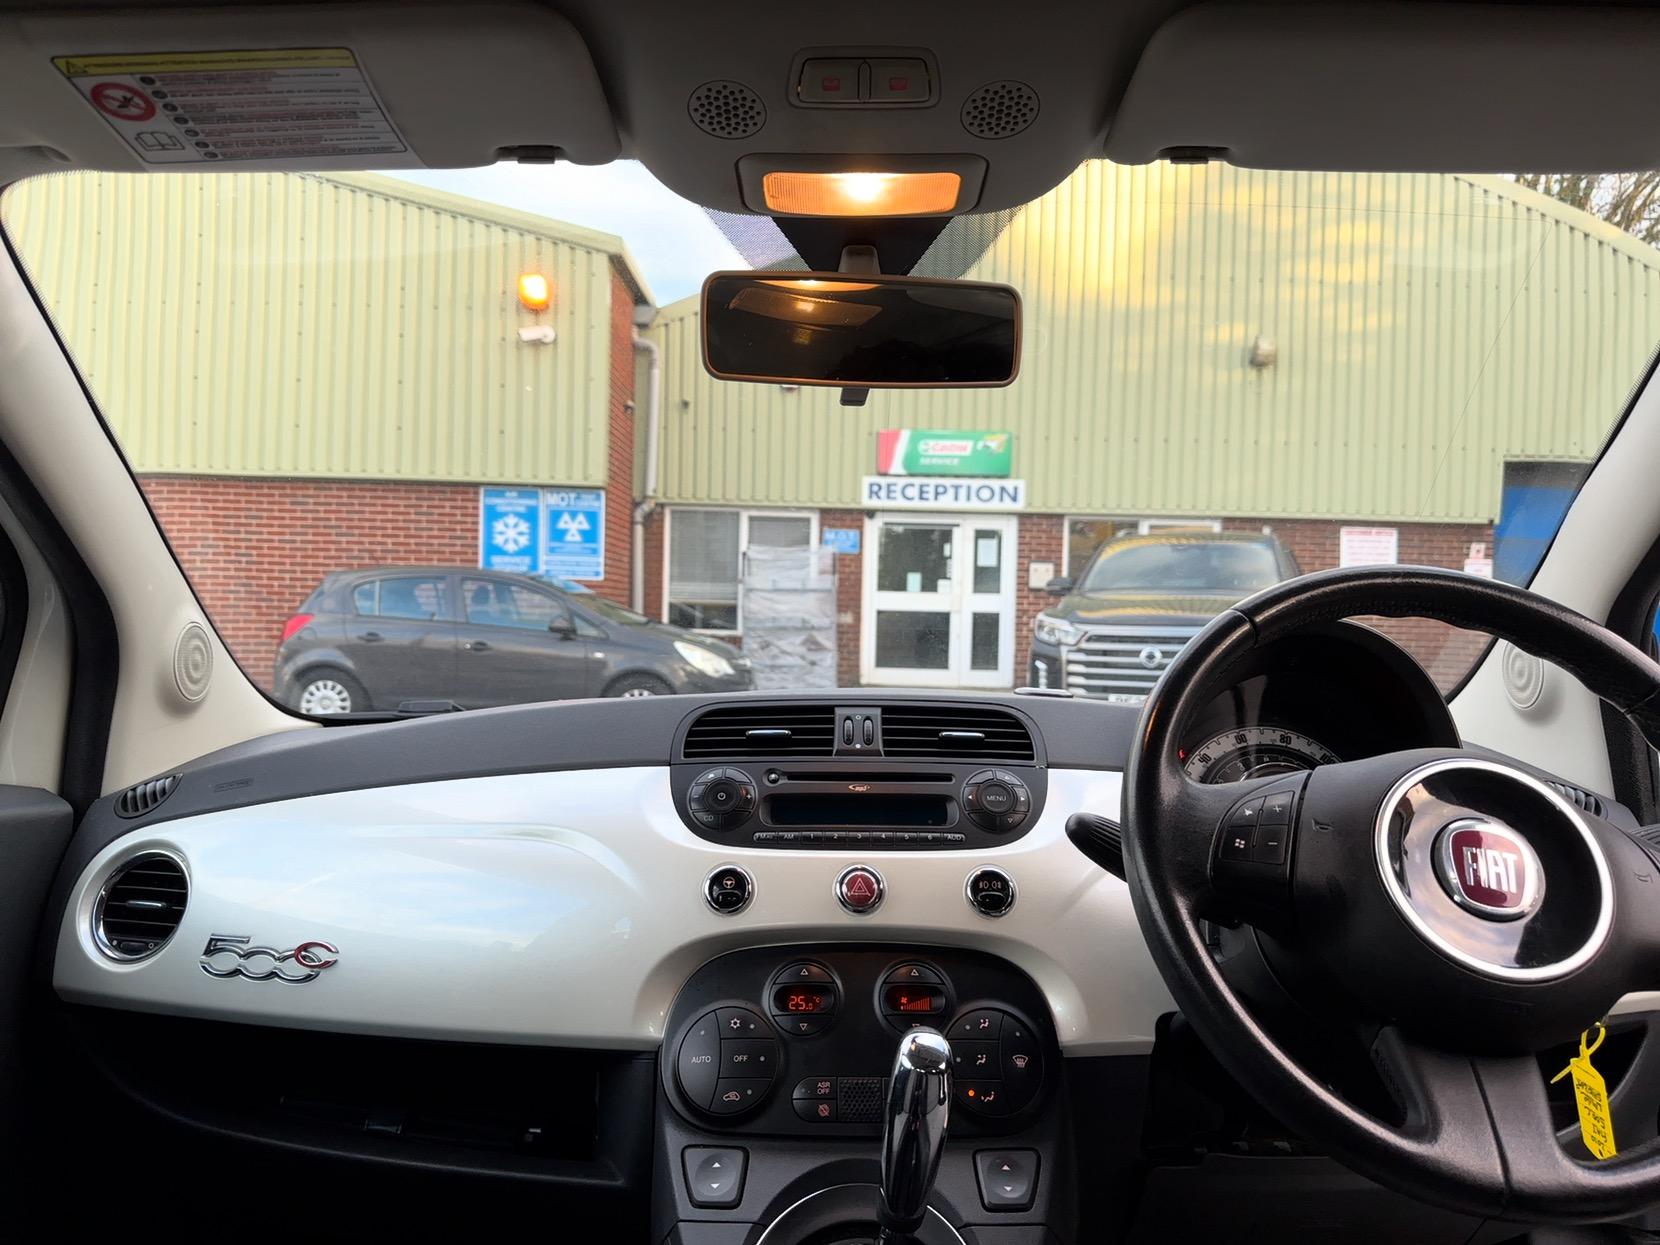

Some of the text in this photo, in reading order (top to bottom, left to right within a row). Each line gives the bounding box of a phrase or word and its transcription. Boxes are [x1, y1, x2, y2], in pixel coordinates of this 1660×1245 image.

[546, 491, 576, 507] MOT
[868, 482, 1018, 503] RECEPTION
[1279, 734, 1293, 745] 80
[1197, 752, 1213, 765] 40
[1462, 846, 1518, 894] FIAT
[691, 1055, 711, 1063] AUTO
